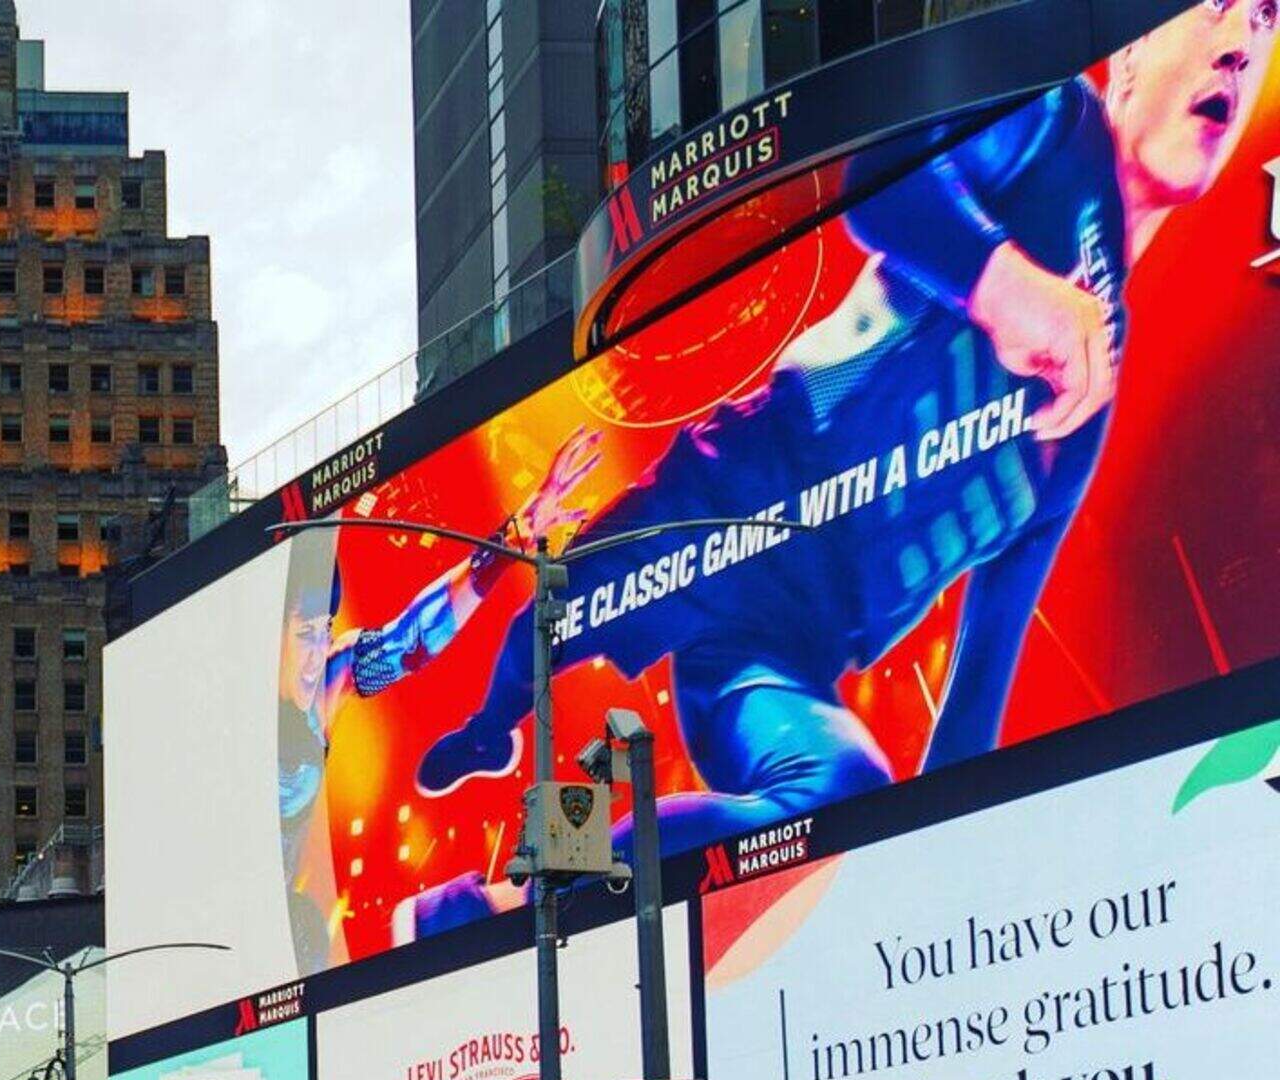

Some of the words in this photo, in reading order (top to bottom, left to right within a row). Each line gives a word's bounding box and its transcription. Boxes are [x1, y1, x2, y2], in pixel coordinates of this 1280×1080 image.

[650, 91, 793, 190] MARRIOTT
[650, 133, 777, 222] MARQUIS
[312, 432, 384, 488] MARRIOTT
[312, 462, 377, 512] MARQUIS
[552, 595, 586, 647] HE
[589, 545, 697, 629] CLASSIC
[800, 460, 878, 528] WITH
[883, 449, 908, 495] A
[917, 390, 1038, 479] CATCH.
[738, 817, 814, 855] MARRIOTT
[738, 841, 806, 876] MARQUIS
[874, 934, 957, 990] You
[967, 906, 1074, 971] have
[1088, 880, 1178, 940] our
[258, 982, 305, 1008] MARRIOTT
[258, 1001, 301, 1025] MARQUIS
[1023, 940, 1274, 1055] gratitude.
[448, 1032, 525, 1080] STRAUSS
